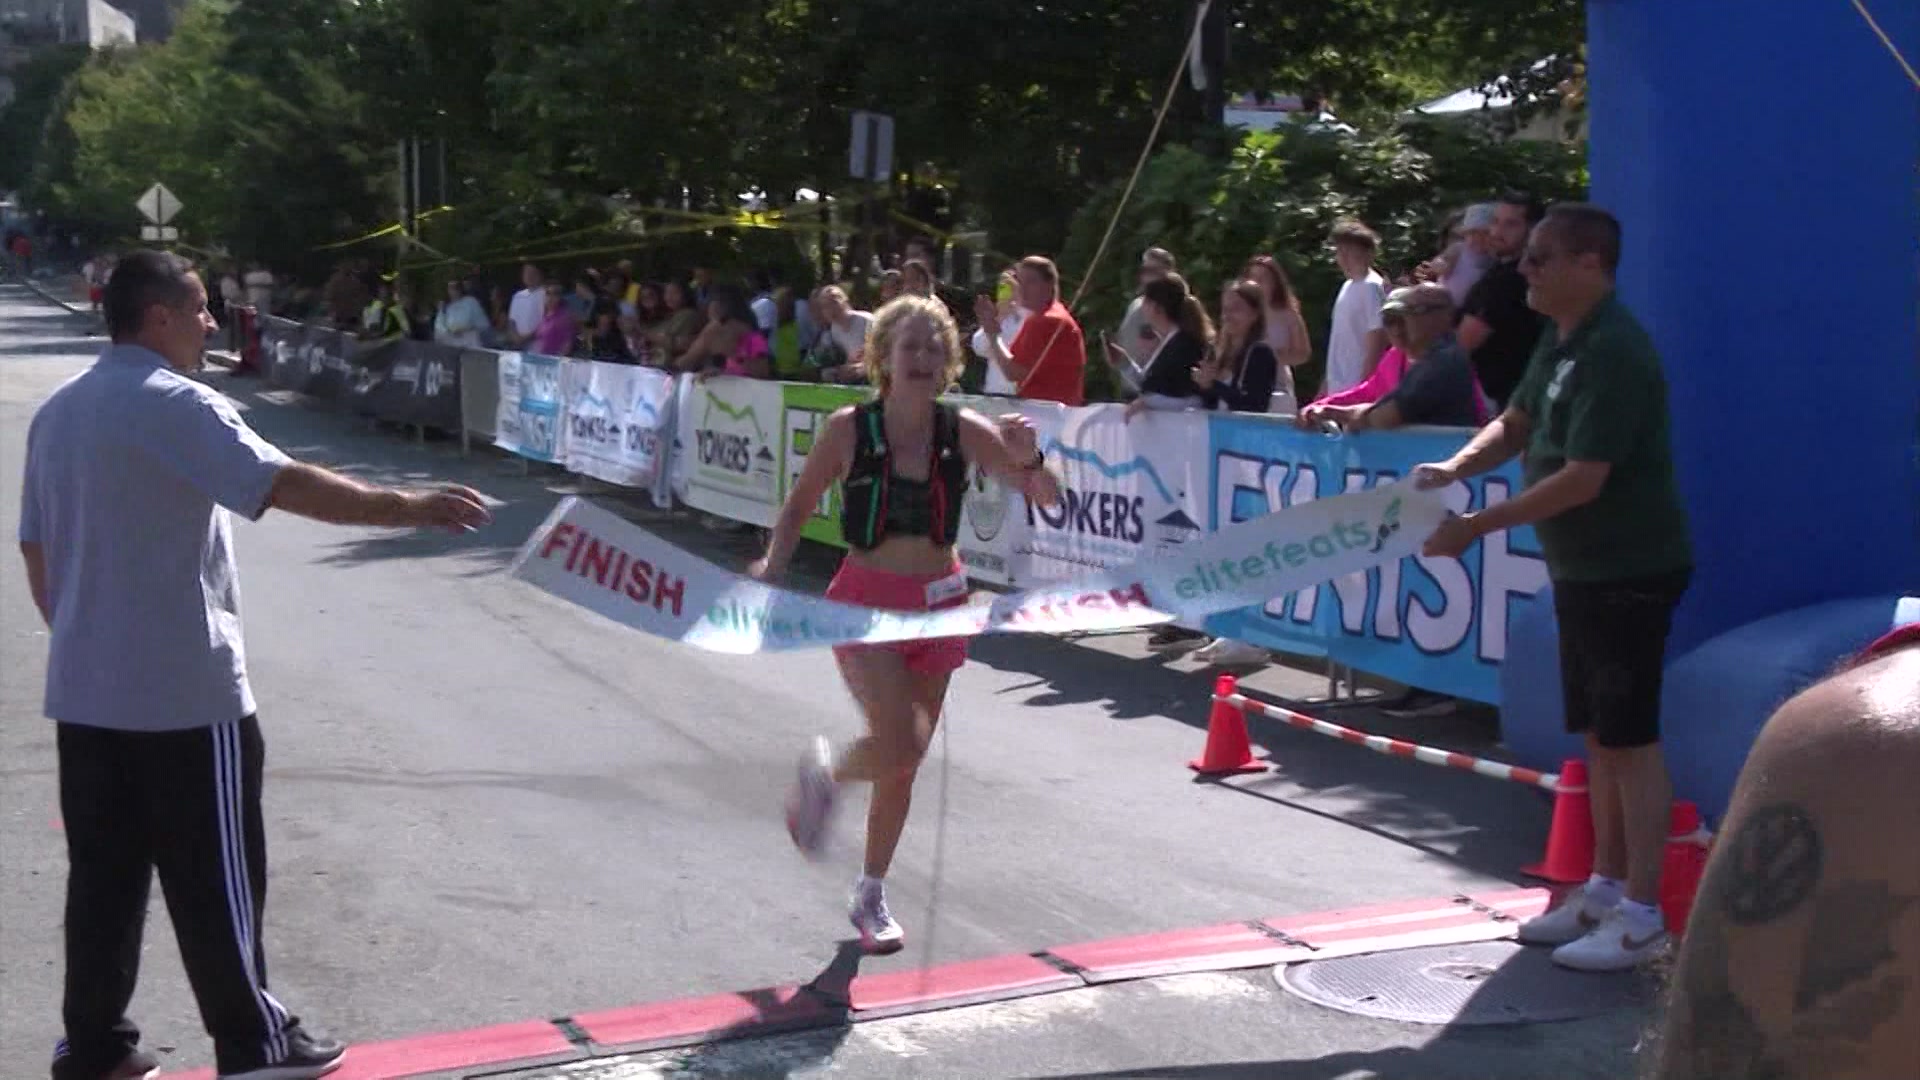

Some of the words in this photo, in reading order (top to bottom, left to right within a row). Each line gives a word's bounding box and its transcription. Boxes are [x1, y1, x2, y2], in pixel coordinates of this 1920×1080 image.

[696, 428, 751, 473] YONKERS
[540, 521, 687, 617] FINISH
[1175, 516, 1374, 601] elitefeats
